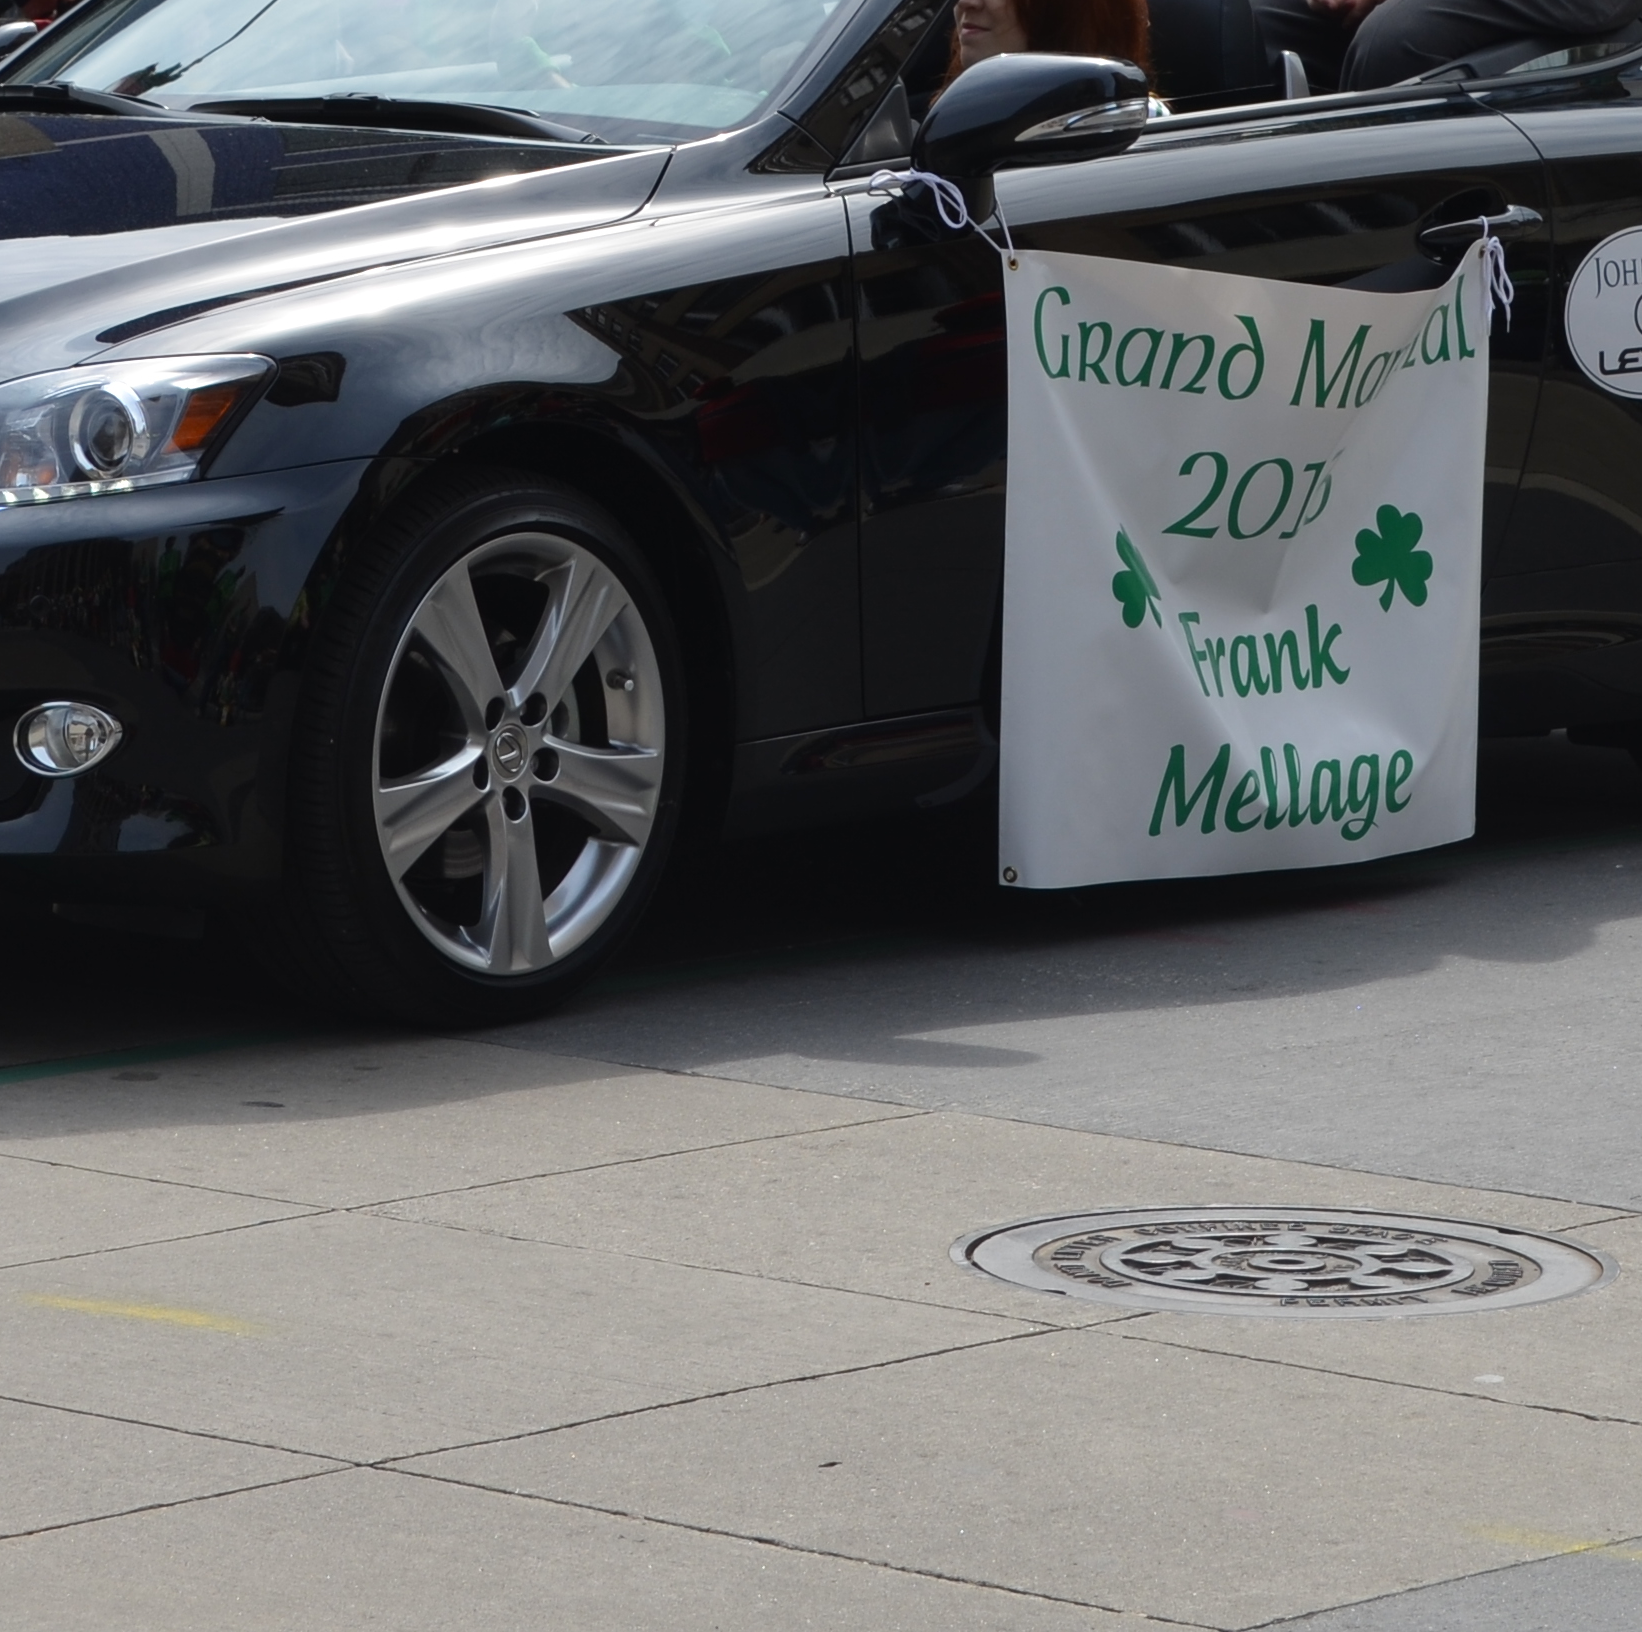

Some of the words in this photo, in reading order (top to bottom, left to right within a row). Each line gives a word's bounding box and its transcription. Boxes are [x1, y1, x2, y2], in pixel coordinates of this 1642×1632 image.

[1033, 285, 1265, 402] Grand
[1289, 273, 1476, 409] Maral
[1178, 604, 1352, 700] Frank
[1148, 743, 1414, 842] Mellage
